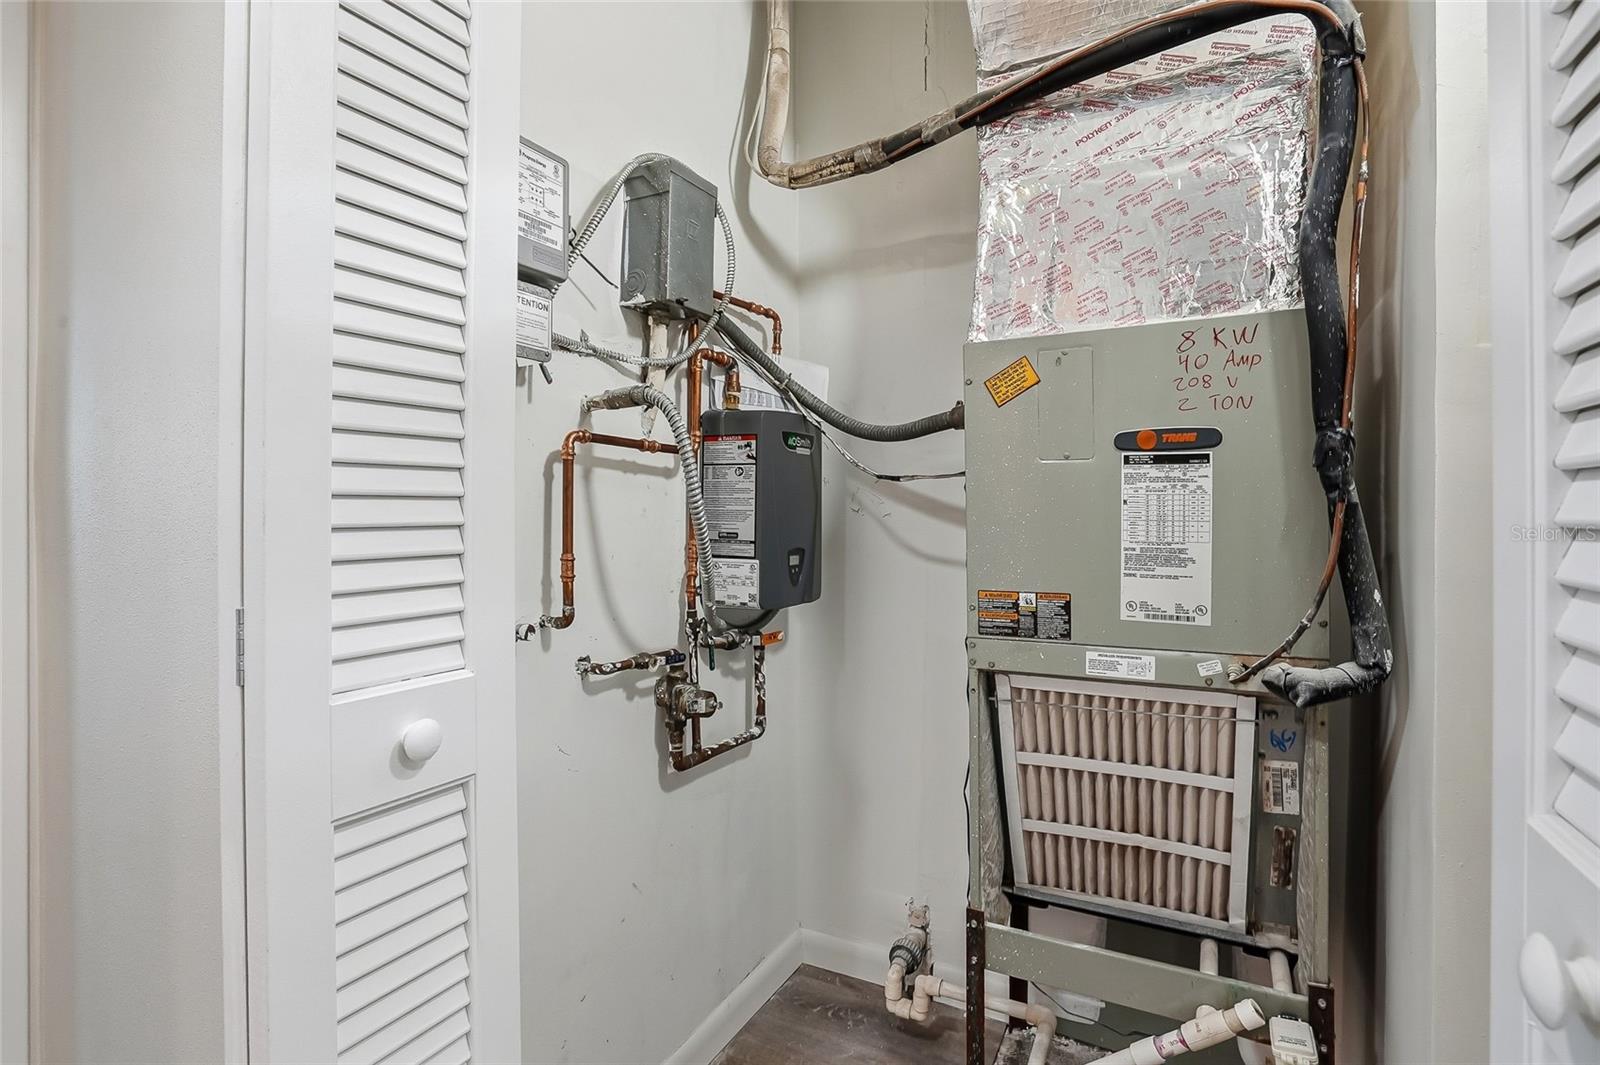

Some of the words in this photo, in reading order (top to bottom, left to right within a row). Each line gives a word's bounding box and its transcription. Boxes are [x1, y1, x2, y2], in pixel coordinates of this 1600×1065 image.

[1177, 327, 1203, 354] 8
[1178, 353, 1209, 375] 40
[1172, 374, 1213, 392] 208
[1178, 398, 1198, 411] 2
[1208, 393, 1254, 411] TON
